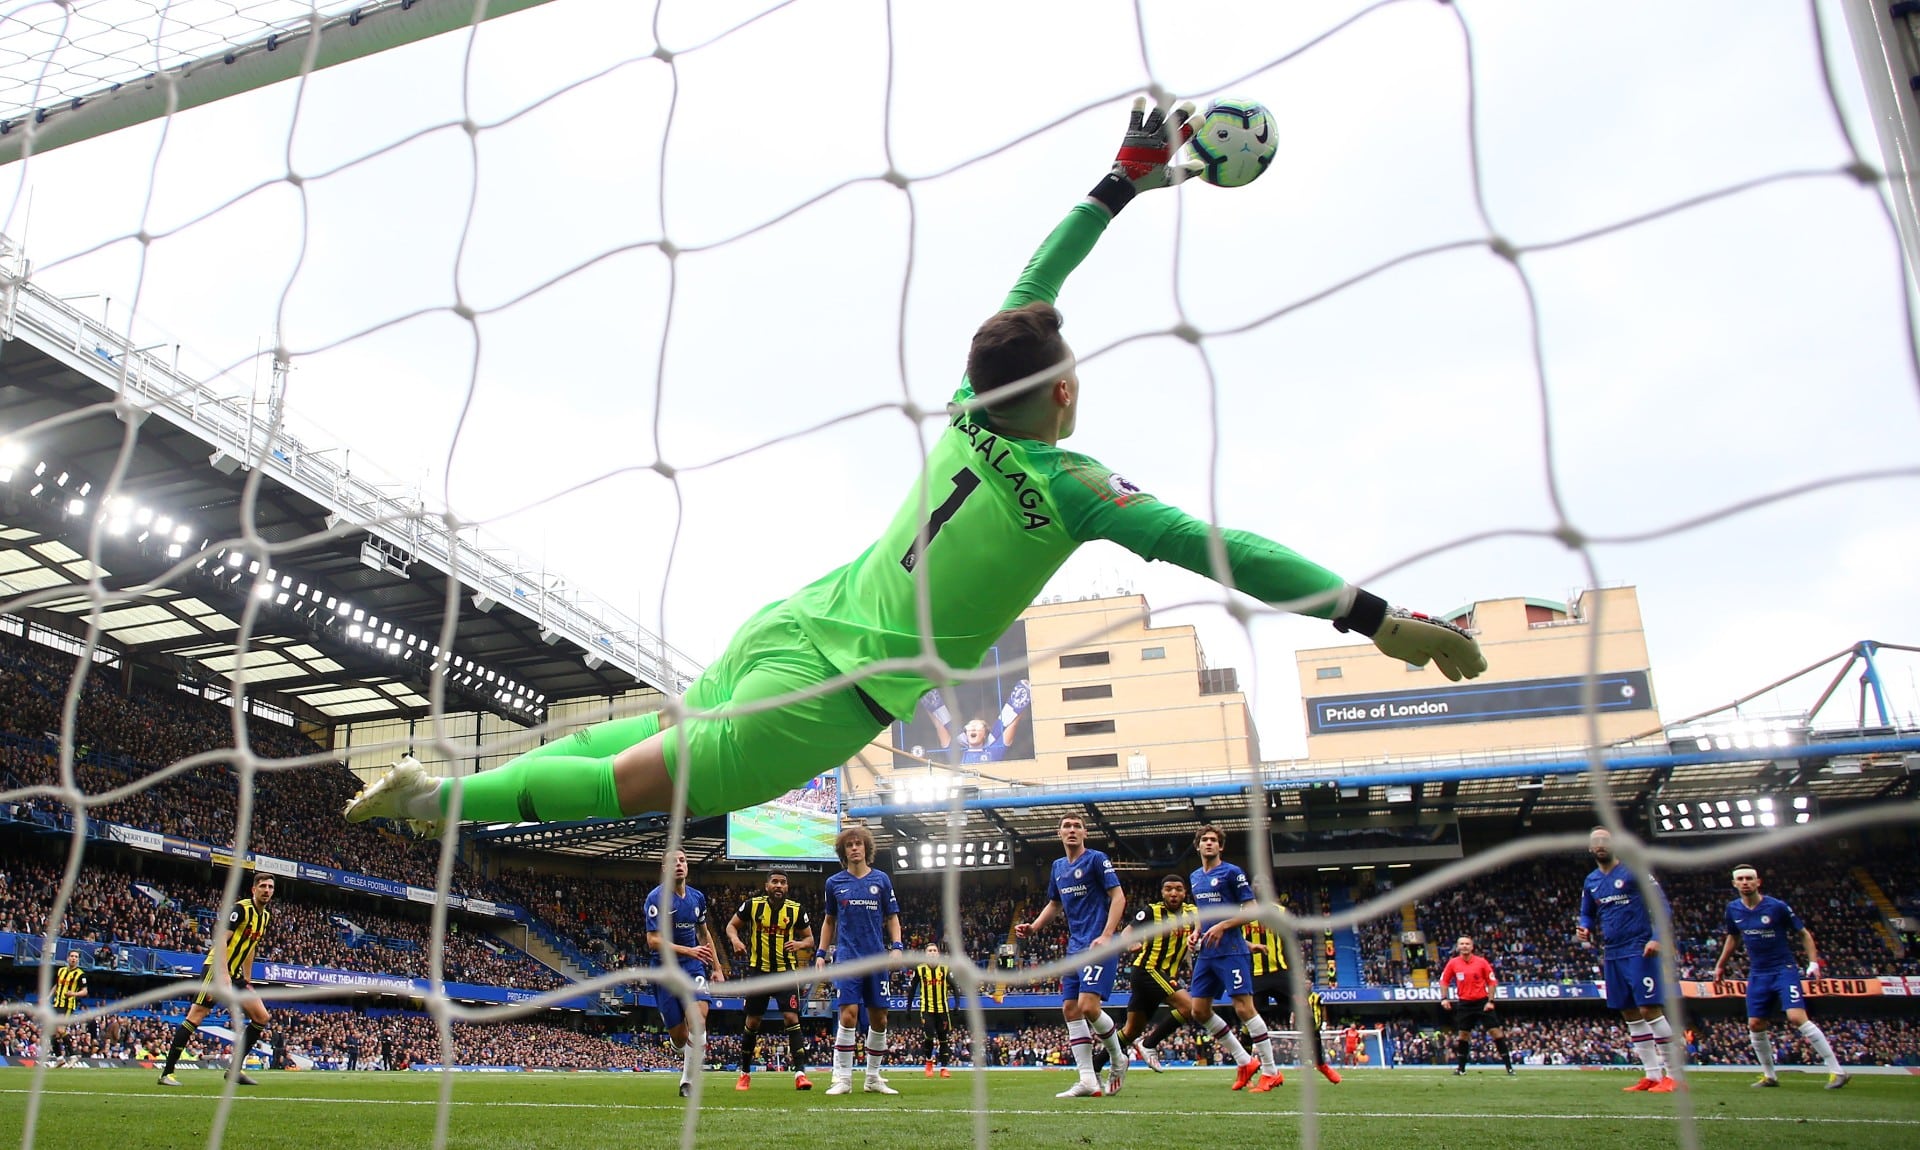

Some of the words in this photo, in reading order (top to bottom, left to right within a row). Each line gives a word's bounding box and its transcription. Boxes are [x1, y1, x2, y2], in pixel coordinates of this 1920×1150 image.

[900, 466, 982, 573] 1
[1326, 706, 1366, 722] Pride
[1370, 703, 1386, 718] of
[1390, 700, 1449, 717] London
[343, 875, 367, 887] CHELSEA
[367, 881, 393, 893] FOOTBALL
[393, 886, 406, 896] CLUB
[1060, 885, 1088, 895] YOKOHAMA
[1196, 892, 1221, 900] YOKOHAMA
[280, 967, 297, 980] THEY
[298, 969, 318, 982] DON'T
[319, 973, 337, 984] MAKE
[338, 974, 354, 985] THEM
[354, 976, 366, 986] LIKE
[367, 977, 378, 987] RAY
[379, 979, 408, 989] ANYMORE
[1083, 965, 1103, 981] 27
[1232, 968, 1243, 985] 3
[1643, 976, 1655, 993] 9
[1713, 981, 1748, 996] DRO
[1789, 984, 1800, 999] 5
[1318, 991, 1357, 1001] ONDON
[1394, 987, 1442, 1001] BORN
[1514, 985, 1560, 999] KING
[789, 994, 798, 1009] 6
